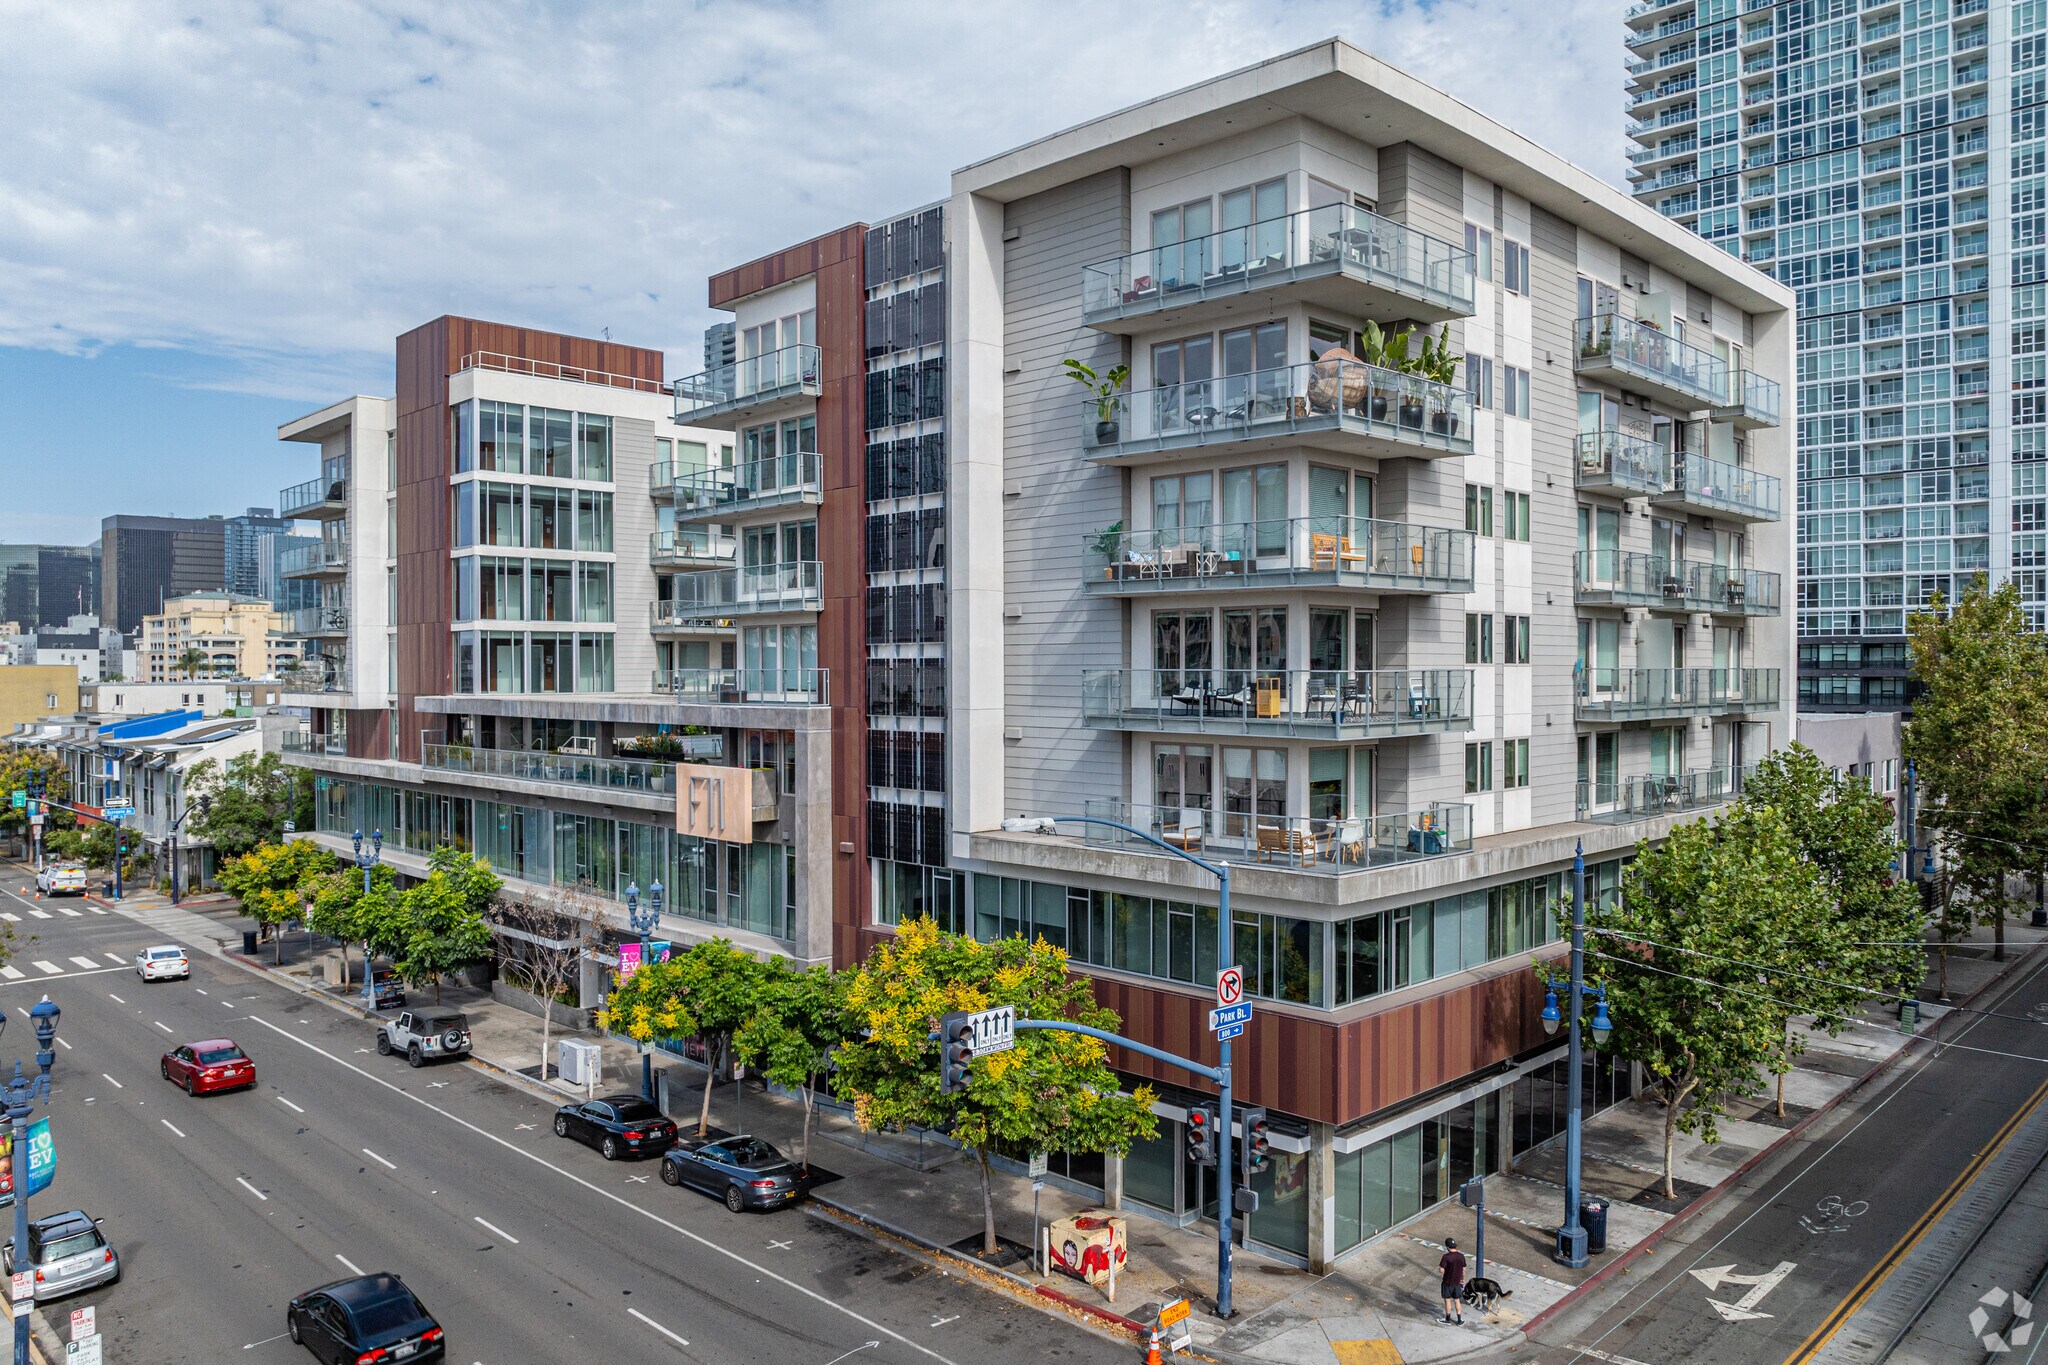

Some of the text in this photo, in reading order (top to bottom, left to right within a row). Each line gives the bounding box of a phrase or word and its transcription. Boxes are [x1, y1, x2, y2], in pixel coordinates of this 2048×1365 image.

[622, 953, 628, 962] I
[622, 962, 638, 971] EV
[1220, 1010, 1236, 1024] PARK
[28, 1138, 38, 1154] I
[29, 1148, 52, 1169] EV
[74, 1316, 93, 1325] PARKING
[1164, 1310, 1187, 1324] ROAD WORK
[70, 1344, 77, 1352] P
[80, 1341, 98, 1350] PARKING
